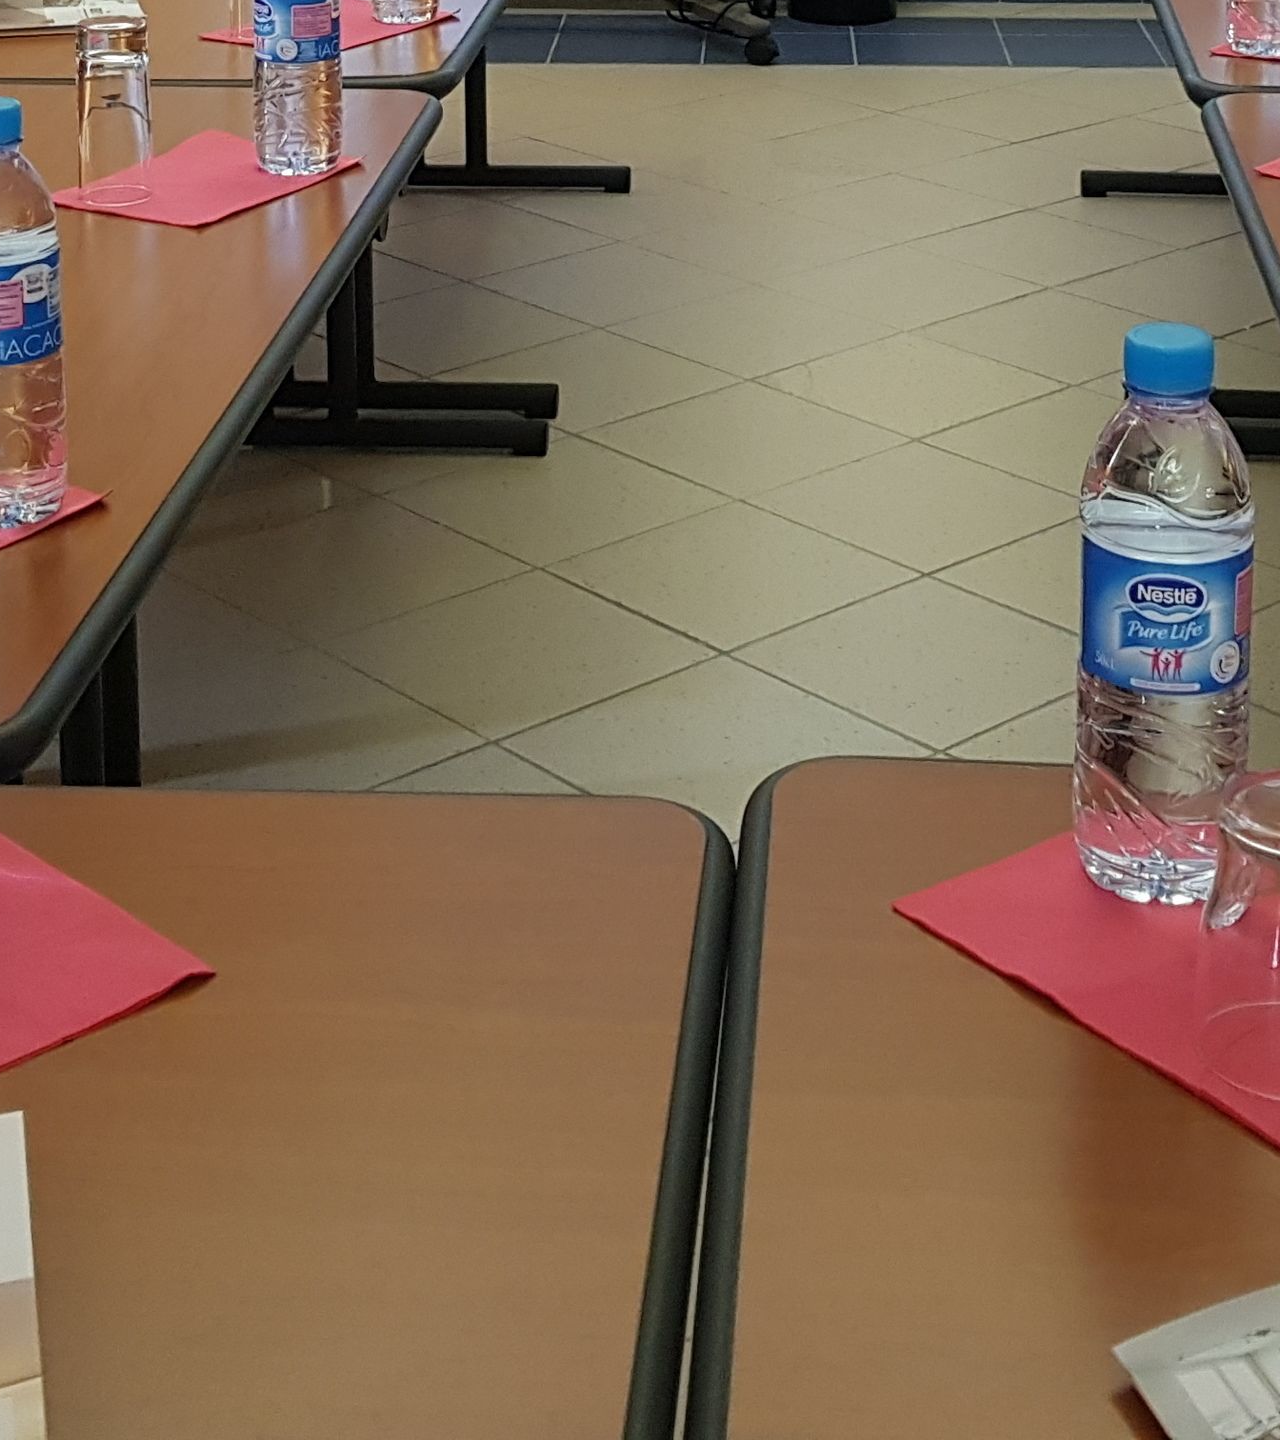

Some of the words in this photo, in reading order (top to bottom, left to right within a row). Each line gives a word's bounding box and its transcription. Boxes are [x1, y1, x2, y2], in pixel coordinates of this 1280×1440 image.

[1137, 583, 1198, 604] Nestlé
[1127, 620, 1167, 640] Pure
[1169, 621, 1204, 641] Life
